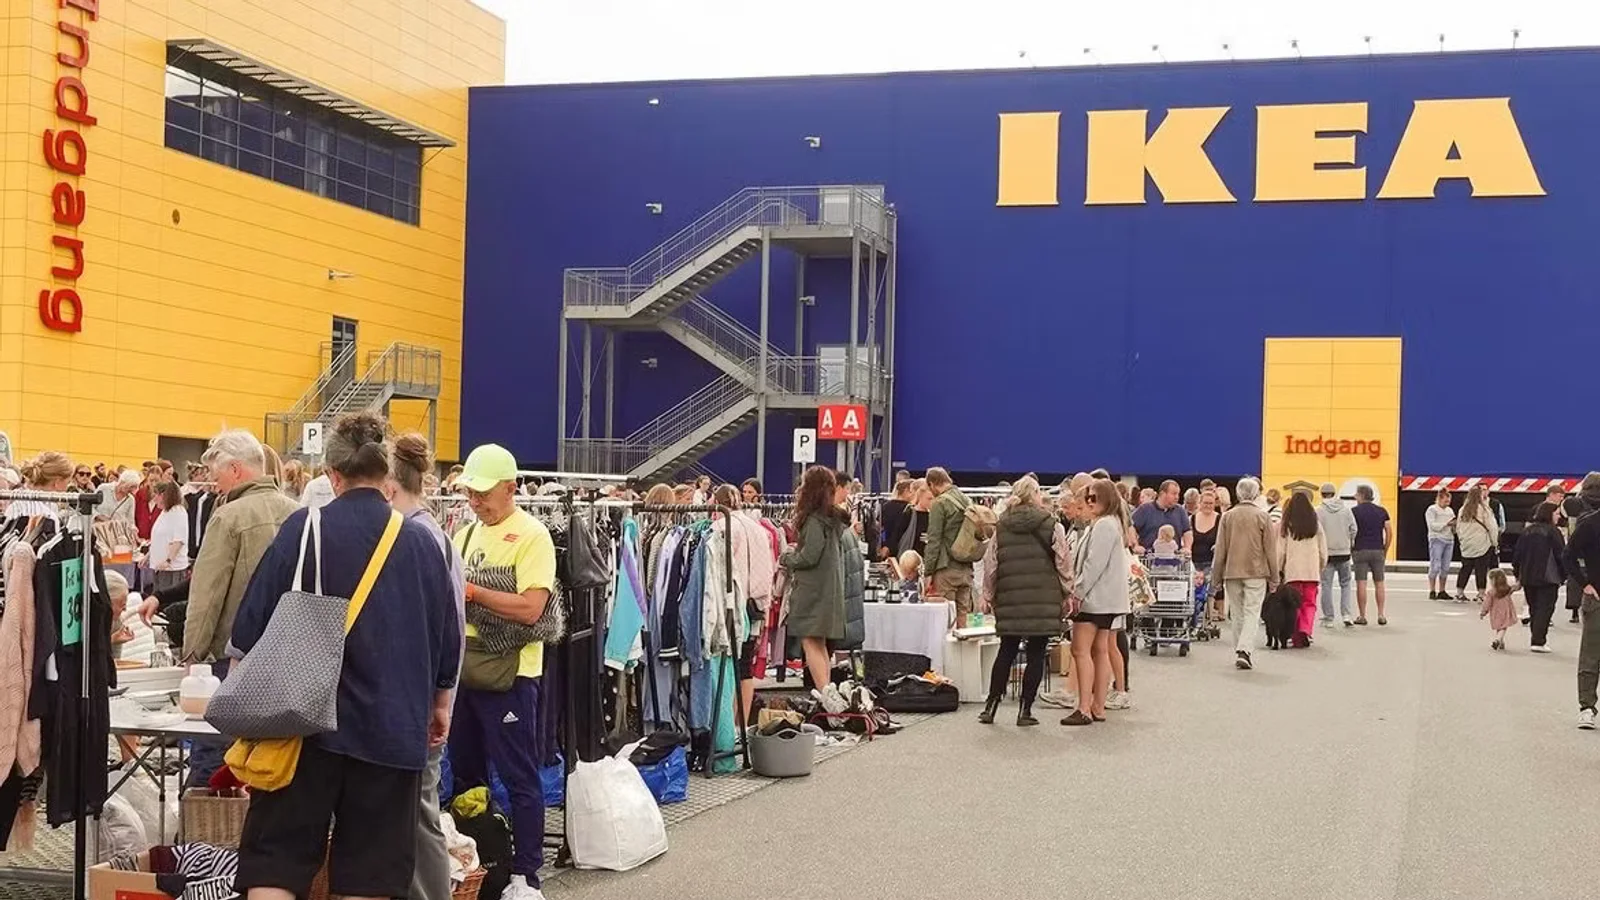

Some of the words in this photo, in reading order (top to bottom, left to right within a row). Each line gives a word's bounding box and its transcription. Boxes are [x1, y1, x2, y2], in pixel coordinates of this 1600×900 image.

[996, 97, 1547, 206] IKEA
[822, 408, 833, 429] A
[842, 409, 859, 430] A
[308, 428, 318, 441] P
[800, 434, 810, 448] P
[1284, 434, 1382, 460] Indgang
